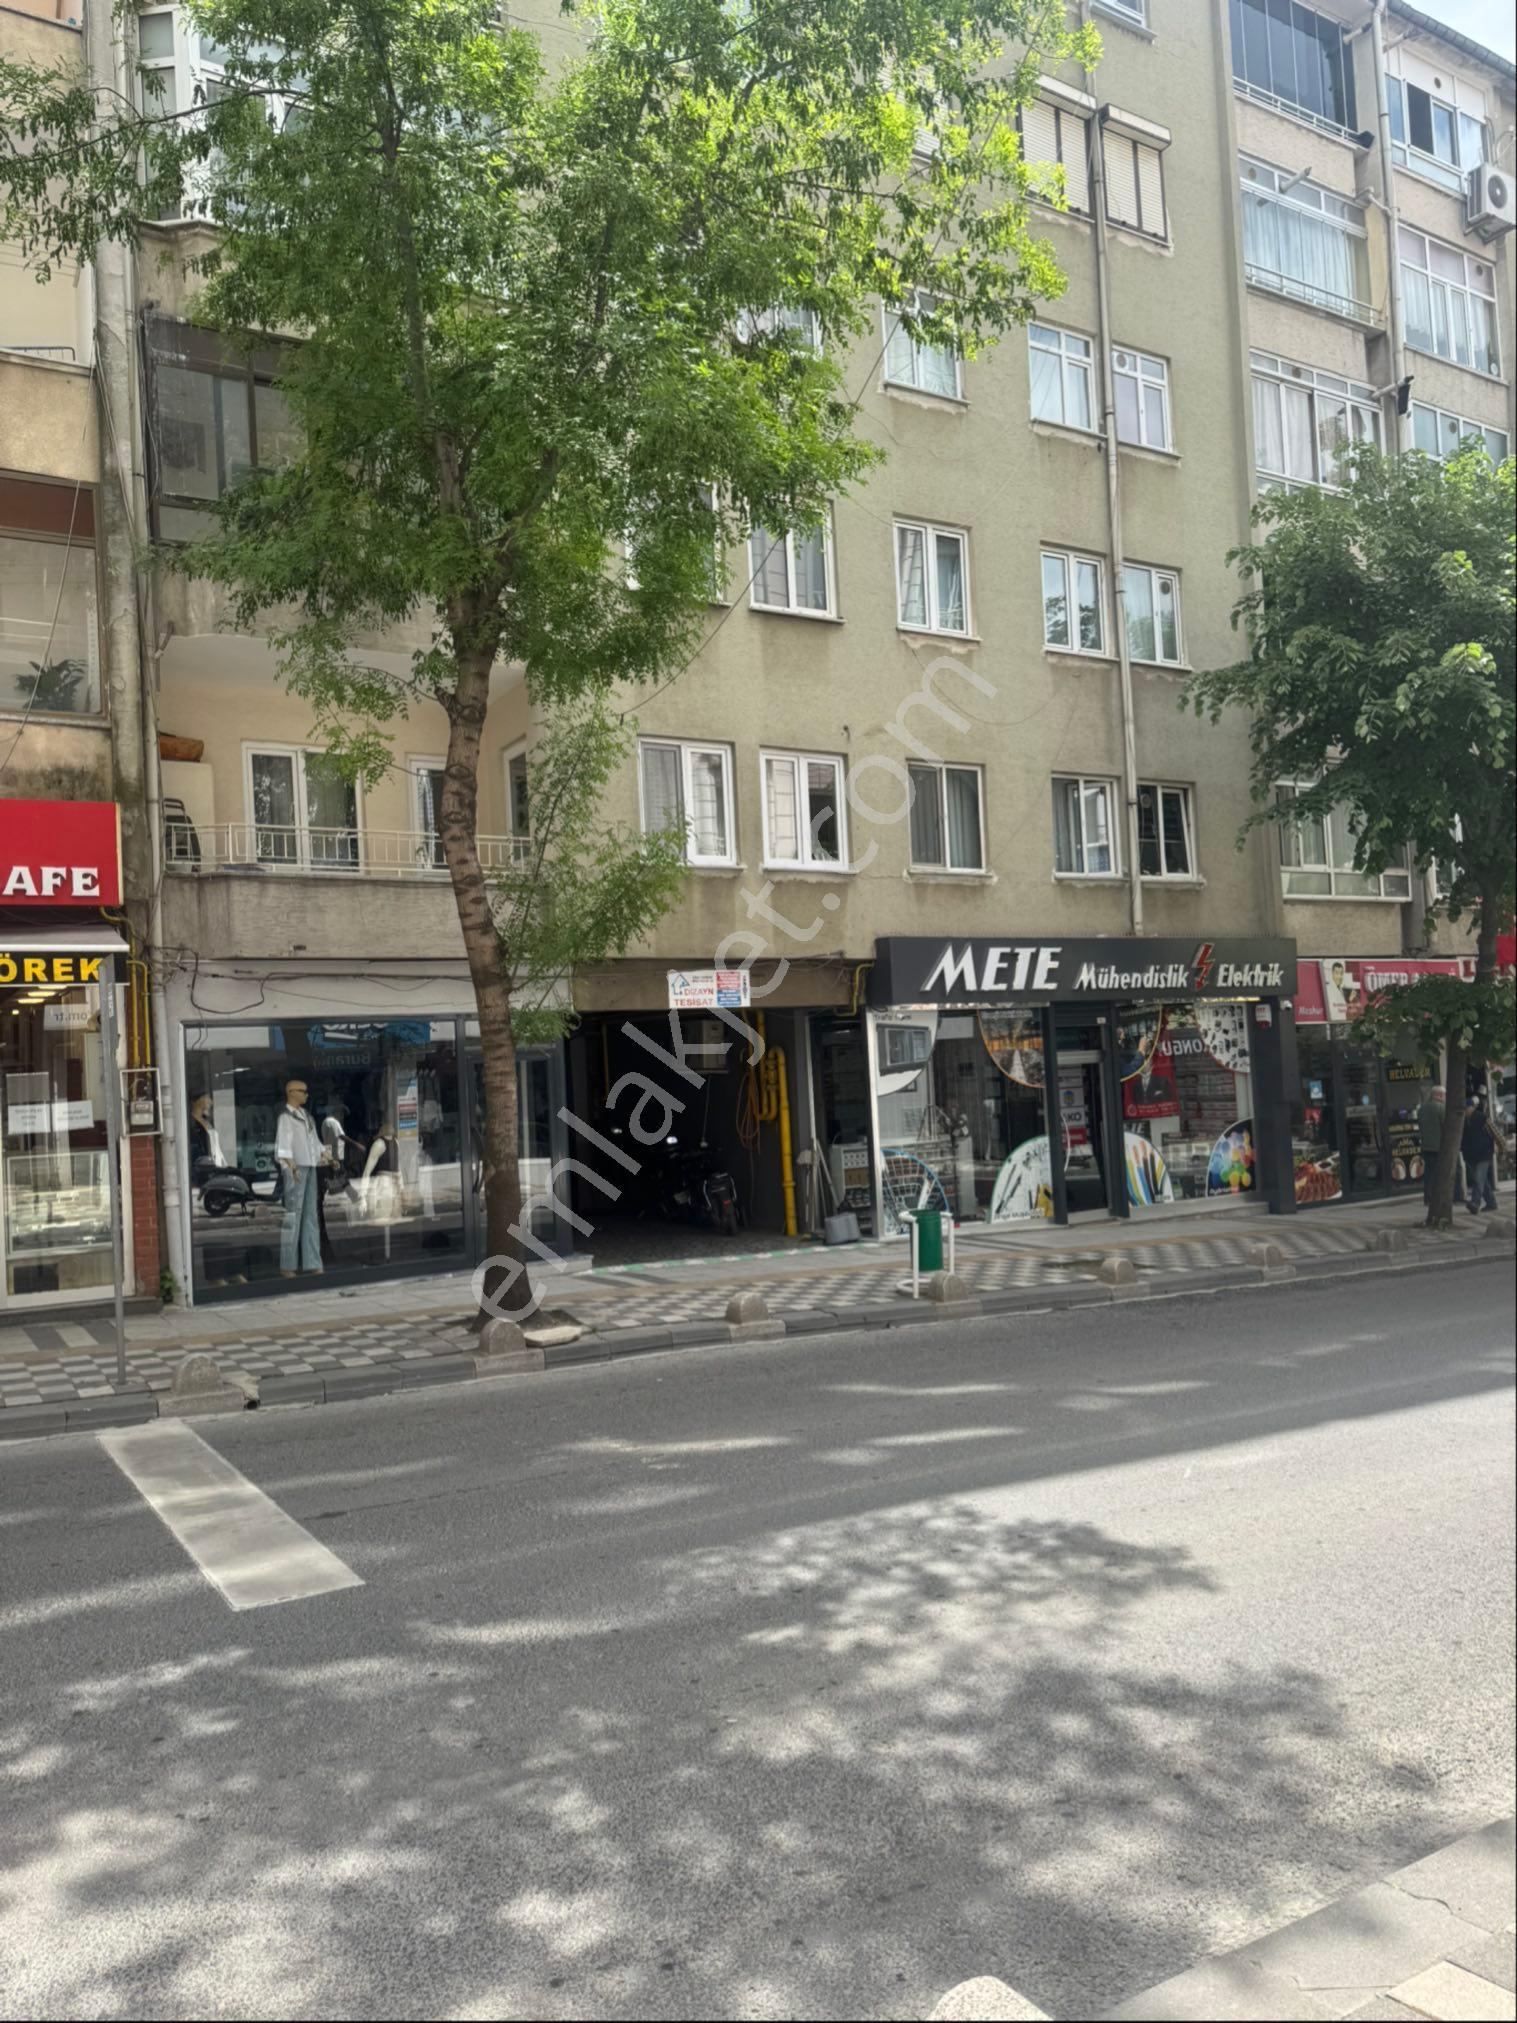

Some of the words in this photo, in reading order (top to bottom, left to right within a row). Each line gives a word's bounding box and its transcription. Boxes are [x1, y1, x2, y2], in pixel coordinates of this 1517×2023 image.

[2, 866, 100, 897] AFE
[0, 952, 103, 982] ÖREK
[920, 943, 1063, 996] METE
[1073, 962, 1189, 991] Mühendislik
[1216, 963, 1284, 988] Elektrik
